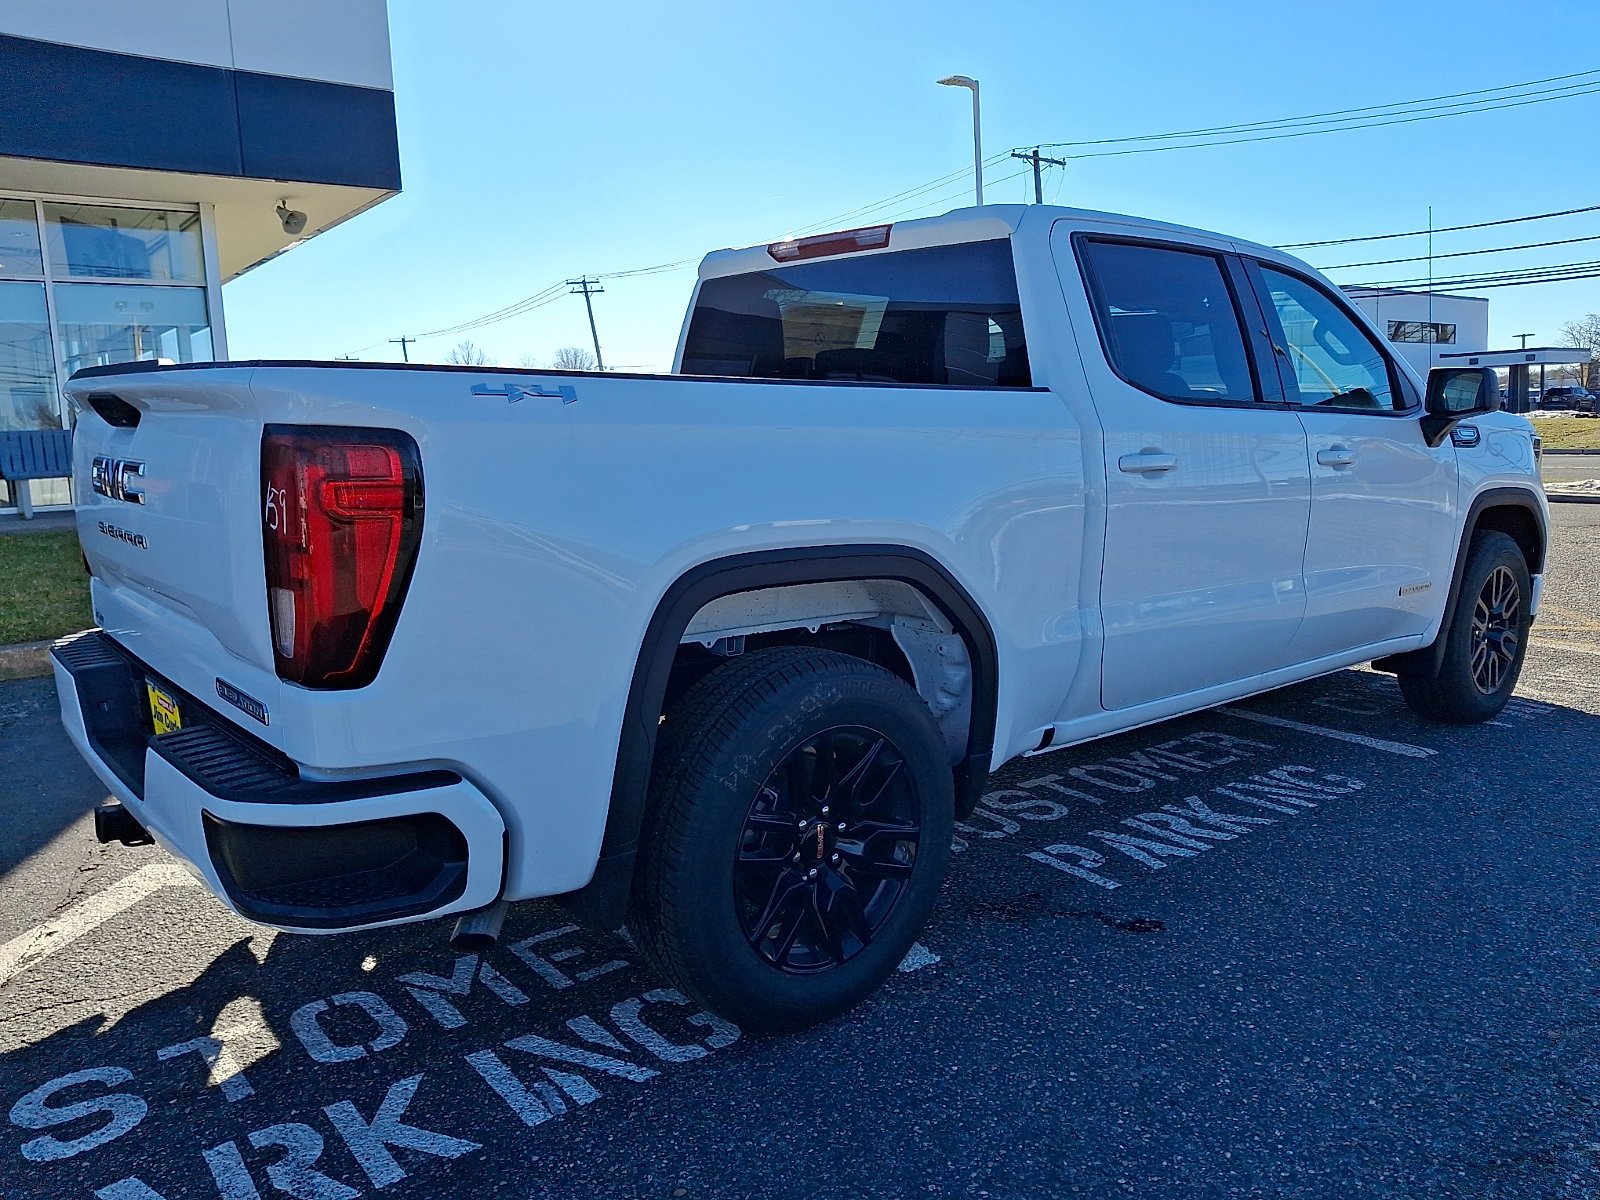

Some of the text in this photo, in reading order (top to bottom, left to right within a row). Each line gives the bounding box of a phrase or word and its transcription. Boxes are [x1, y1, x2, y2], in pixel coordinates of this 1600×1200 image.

[92, 455, 146, 506] GMC
[98, 521, 149, 550] SIERRA
[1027, 764, 1366, 891] PARKING
[8, 924, 638, 1163] STOME
